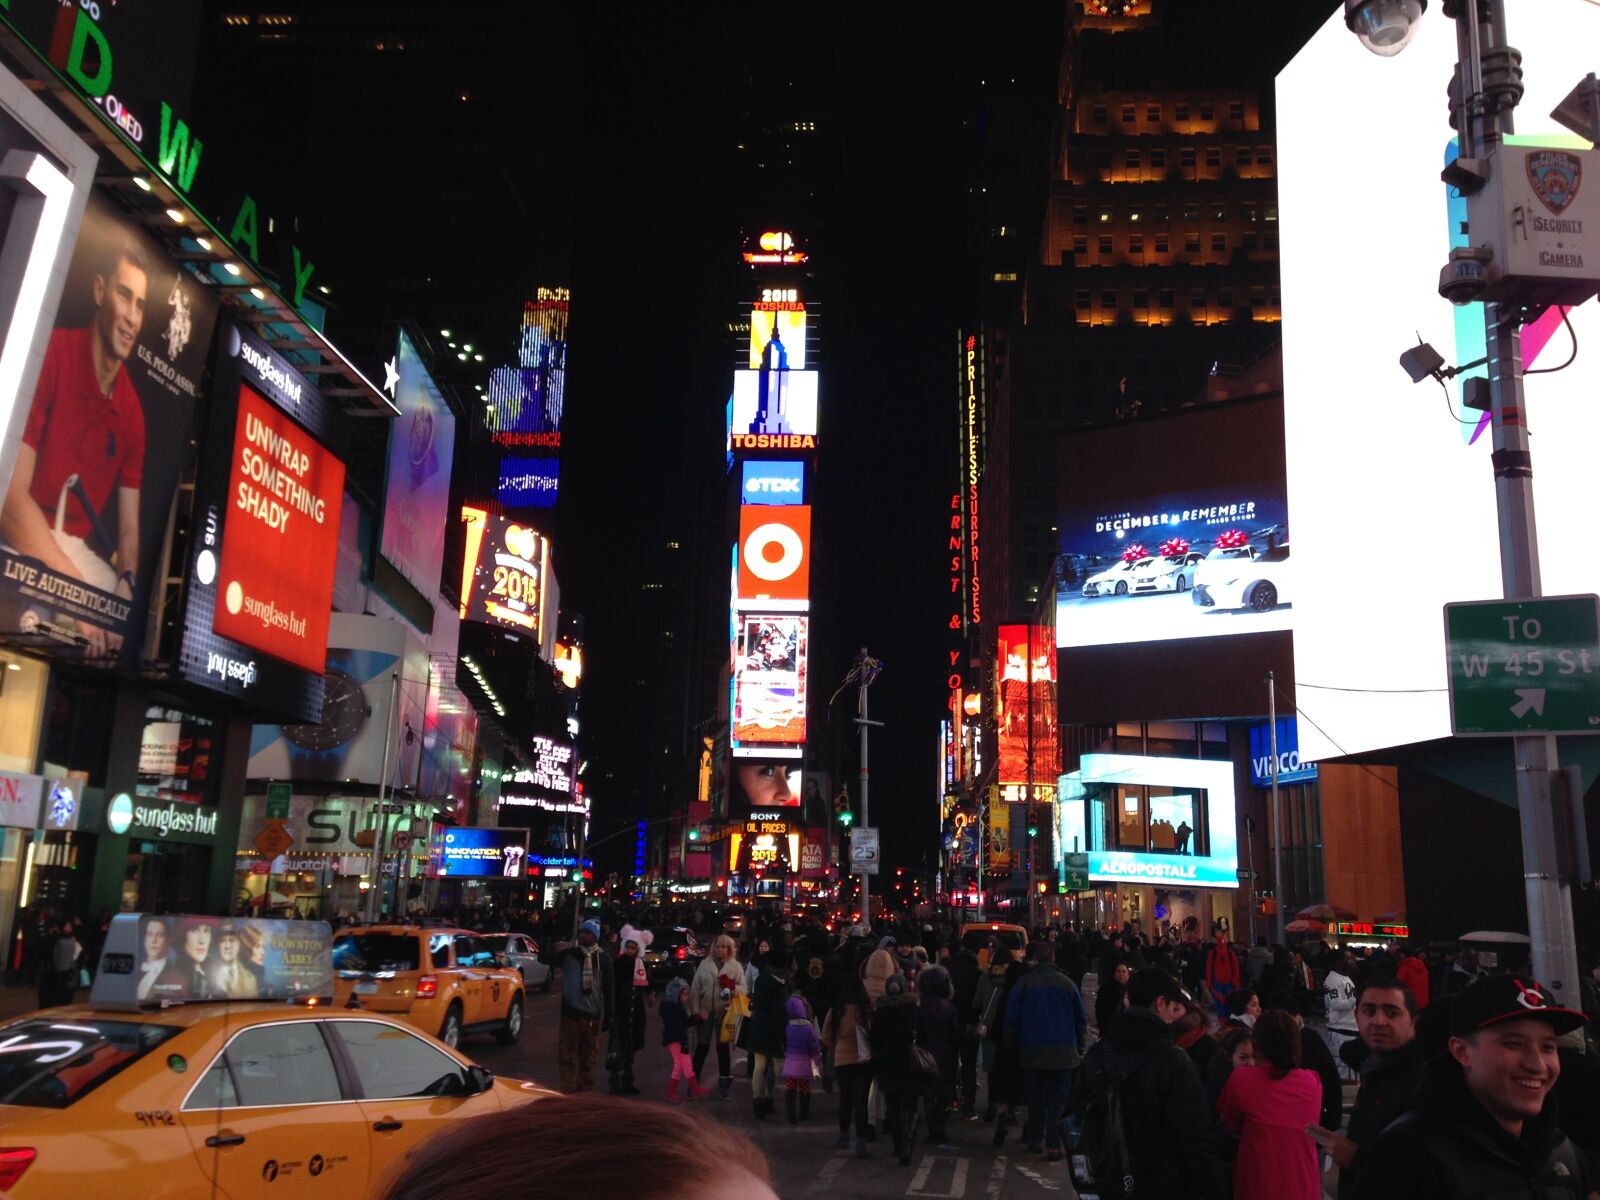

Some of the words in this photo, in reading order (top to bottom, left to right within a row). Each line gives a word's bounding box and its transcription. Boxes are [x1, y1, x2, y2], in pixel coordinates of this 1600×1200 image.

[105, 94, 143, 142] OLED
[1533, 216, 1583, 233] SECURITY
[1539, 250, 1584, 268] CAMERA
[752, 302, 805, 311] TOSHIBA
[153, 355, 176, 380] POLO
[241, 342, 286, 389] sunglass
[284, 373, 302, 404] hut
[245, 412, 310, 478] UNWRAP
[732, 434, 815, 449] TOSHIBA
[240, 447, 325, 524] SOMETHING
[759, 477, 801, 493] TDK
[236, 481, 290, 534] SHADY
[1095, 513, 1169, 533] DECEMBER
[1182, 501, 1256, 522] REMEMBER
[949, 494, 961, 593] ERNST
[3, 559, 39, 587] LIVE
[36, 572, 131, 622] AUTHENTICALLY
[493, 565, 538, 607] 2015
[243, 596, 290, 631] sunglass
[289, 610, 307, 638] hut
[1459, 653, 1490, 678] W
[1503, 651, 1545, 677] 45
[1557, 648, 1593, 675] St
[134, 805, 194, 837] sunglass
[195, 809, 218, 837] hut
[746, 822, 758, 833] OIL
[760, 822, 786, 833] PRICES
[445, 846, 500, 856] INNOVATION
[751, 850, 777, 861] 2015
[801, 844, 822, 856] ATA
[854, 846, 875, 859] 25
[271, 934, 323, 950] DOWNTON
[280, 951, 312, 965] ABBEY
[135, 1110, 177, 1127] 9Y92
